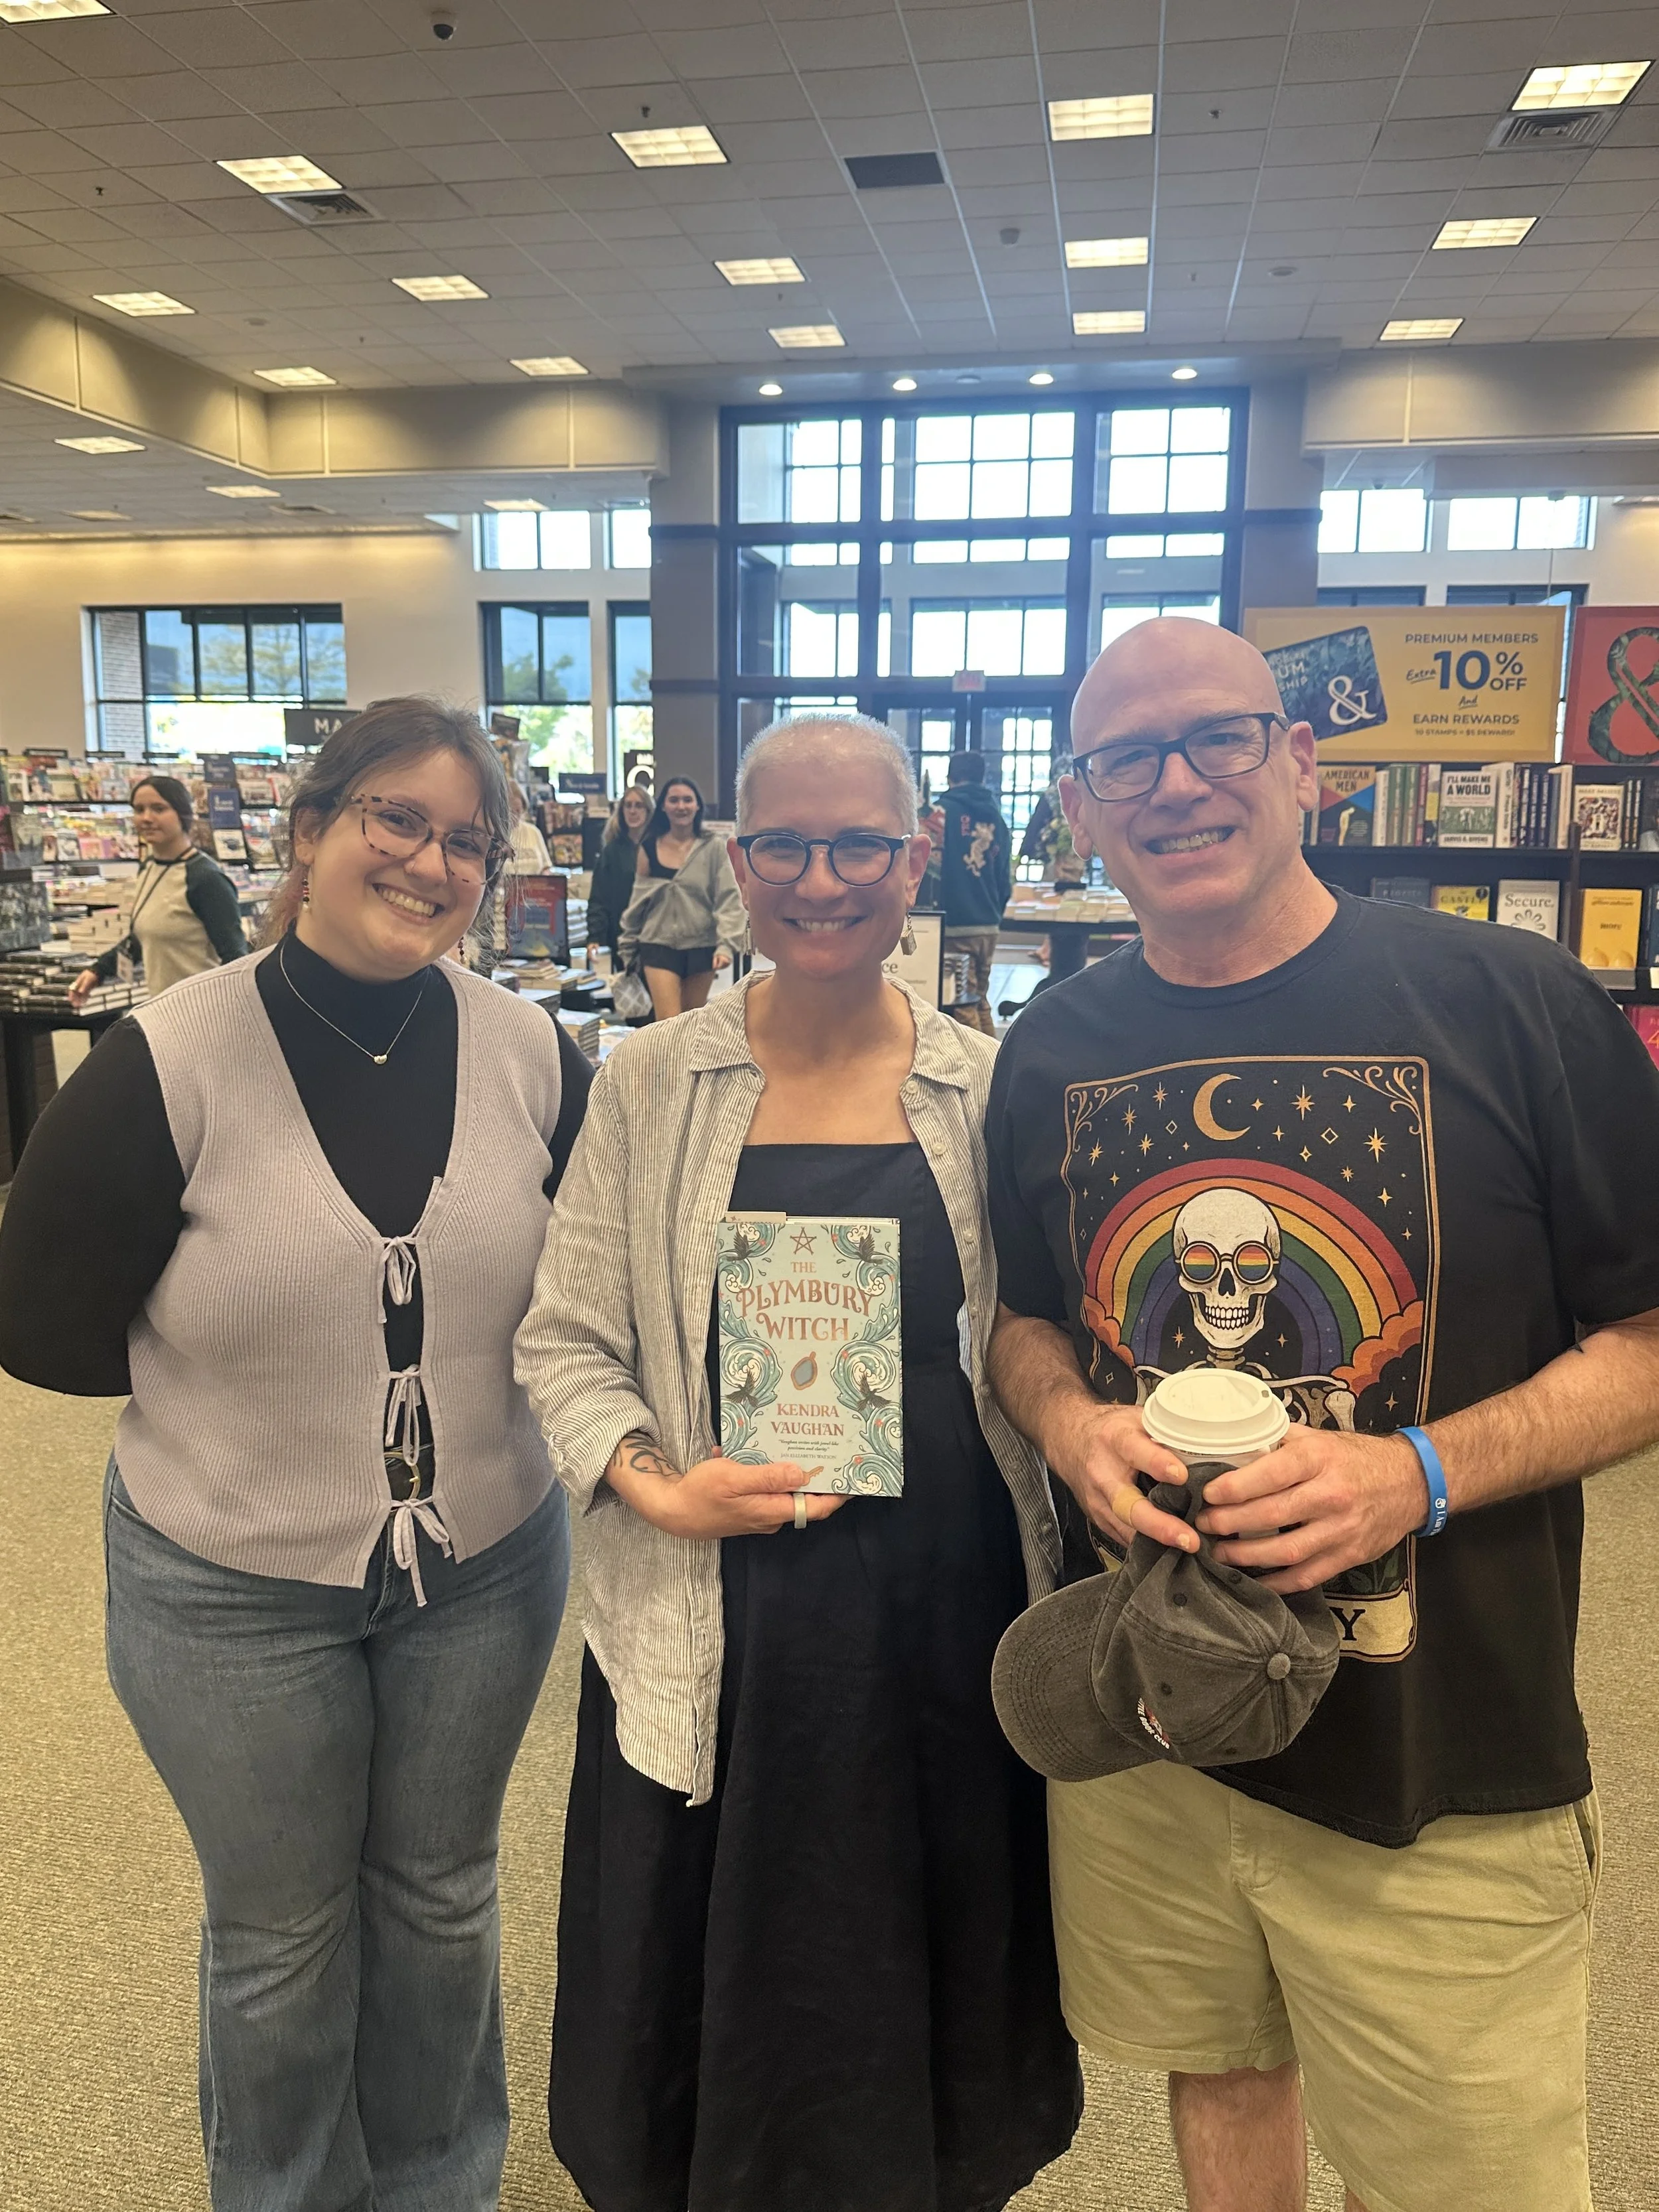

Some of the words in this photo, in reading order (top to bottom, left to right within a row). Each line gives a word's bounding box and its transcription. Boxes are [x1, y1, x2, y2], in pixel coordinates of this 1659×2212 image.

[1405, 633, 1468, 644] PREMIUM
[1472, 633, 1539, 644] MEMBERS
[1406, 668, 1437, 681] Extra
[1490, 677, 1527, 691] OFF
[1459, 695, 1479, 707] And
[1413, 713, 1449, 725] EARN
[1453, 713, 1520, 725] REWARDS
[1325, 769, 1370, 780] AMERICAN
[1447, 775, 1459, 784] I'LL
[1461, 775, 1479, 784] MAKE
[1480, 775, 1491, 784] ME
[1335, 780, 1357, 792] MEN
[1447, 784, 1454, 795] A
[1455, 784, 1491, 795] WORLD
[1504, 893, 1555, 908] Secure.
[790, 1262, 817, 1273] THE
[736, 1279, 875, 1318] PLYMBURY
[756, 1312, 849, 1341] WITCH
[776, 1403, 839, 1418] KENDRA
[770, 1421, 845, 1436] VAUGHAN
[1153, 1734, 1171, 1750] CLUB
